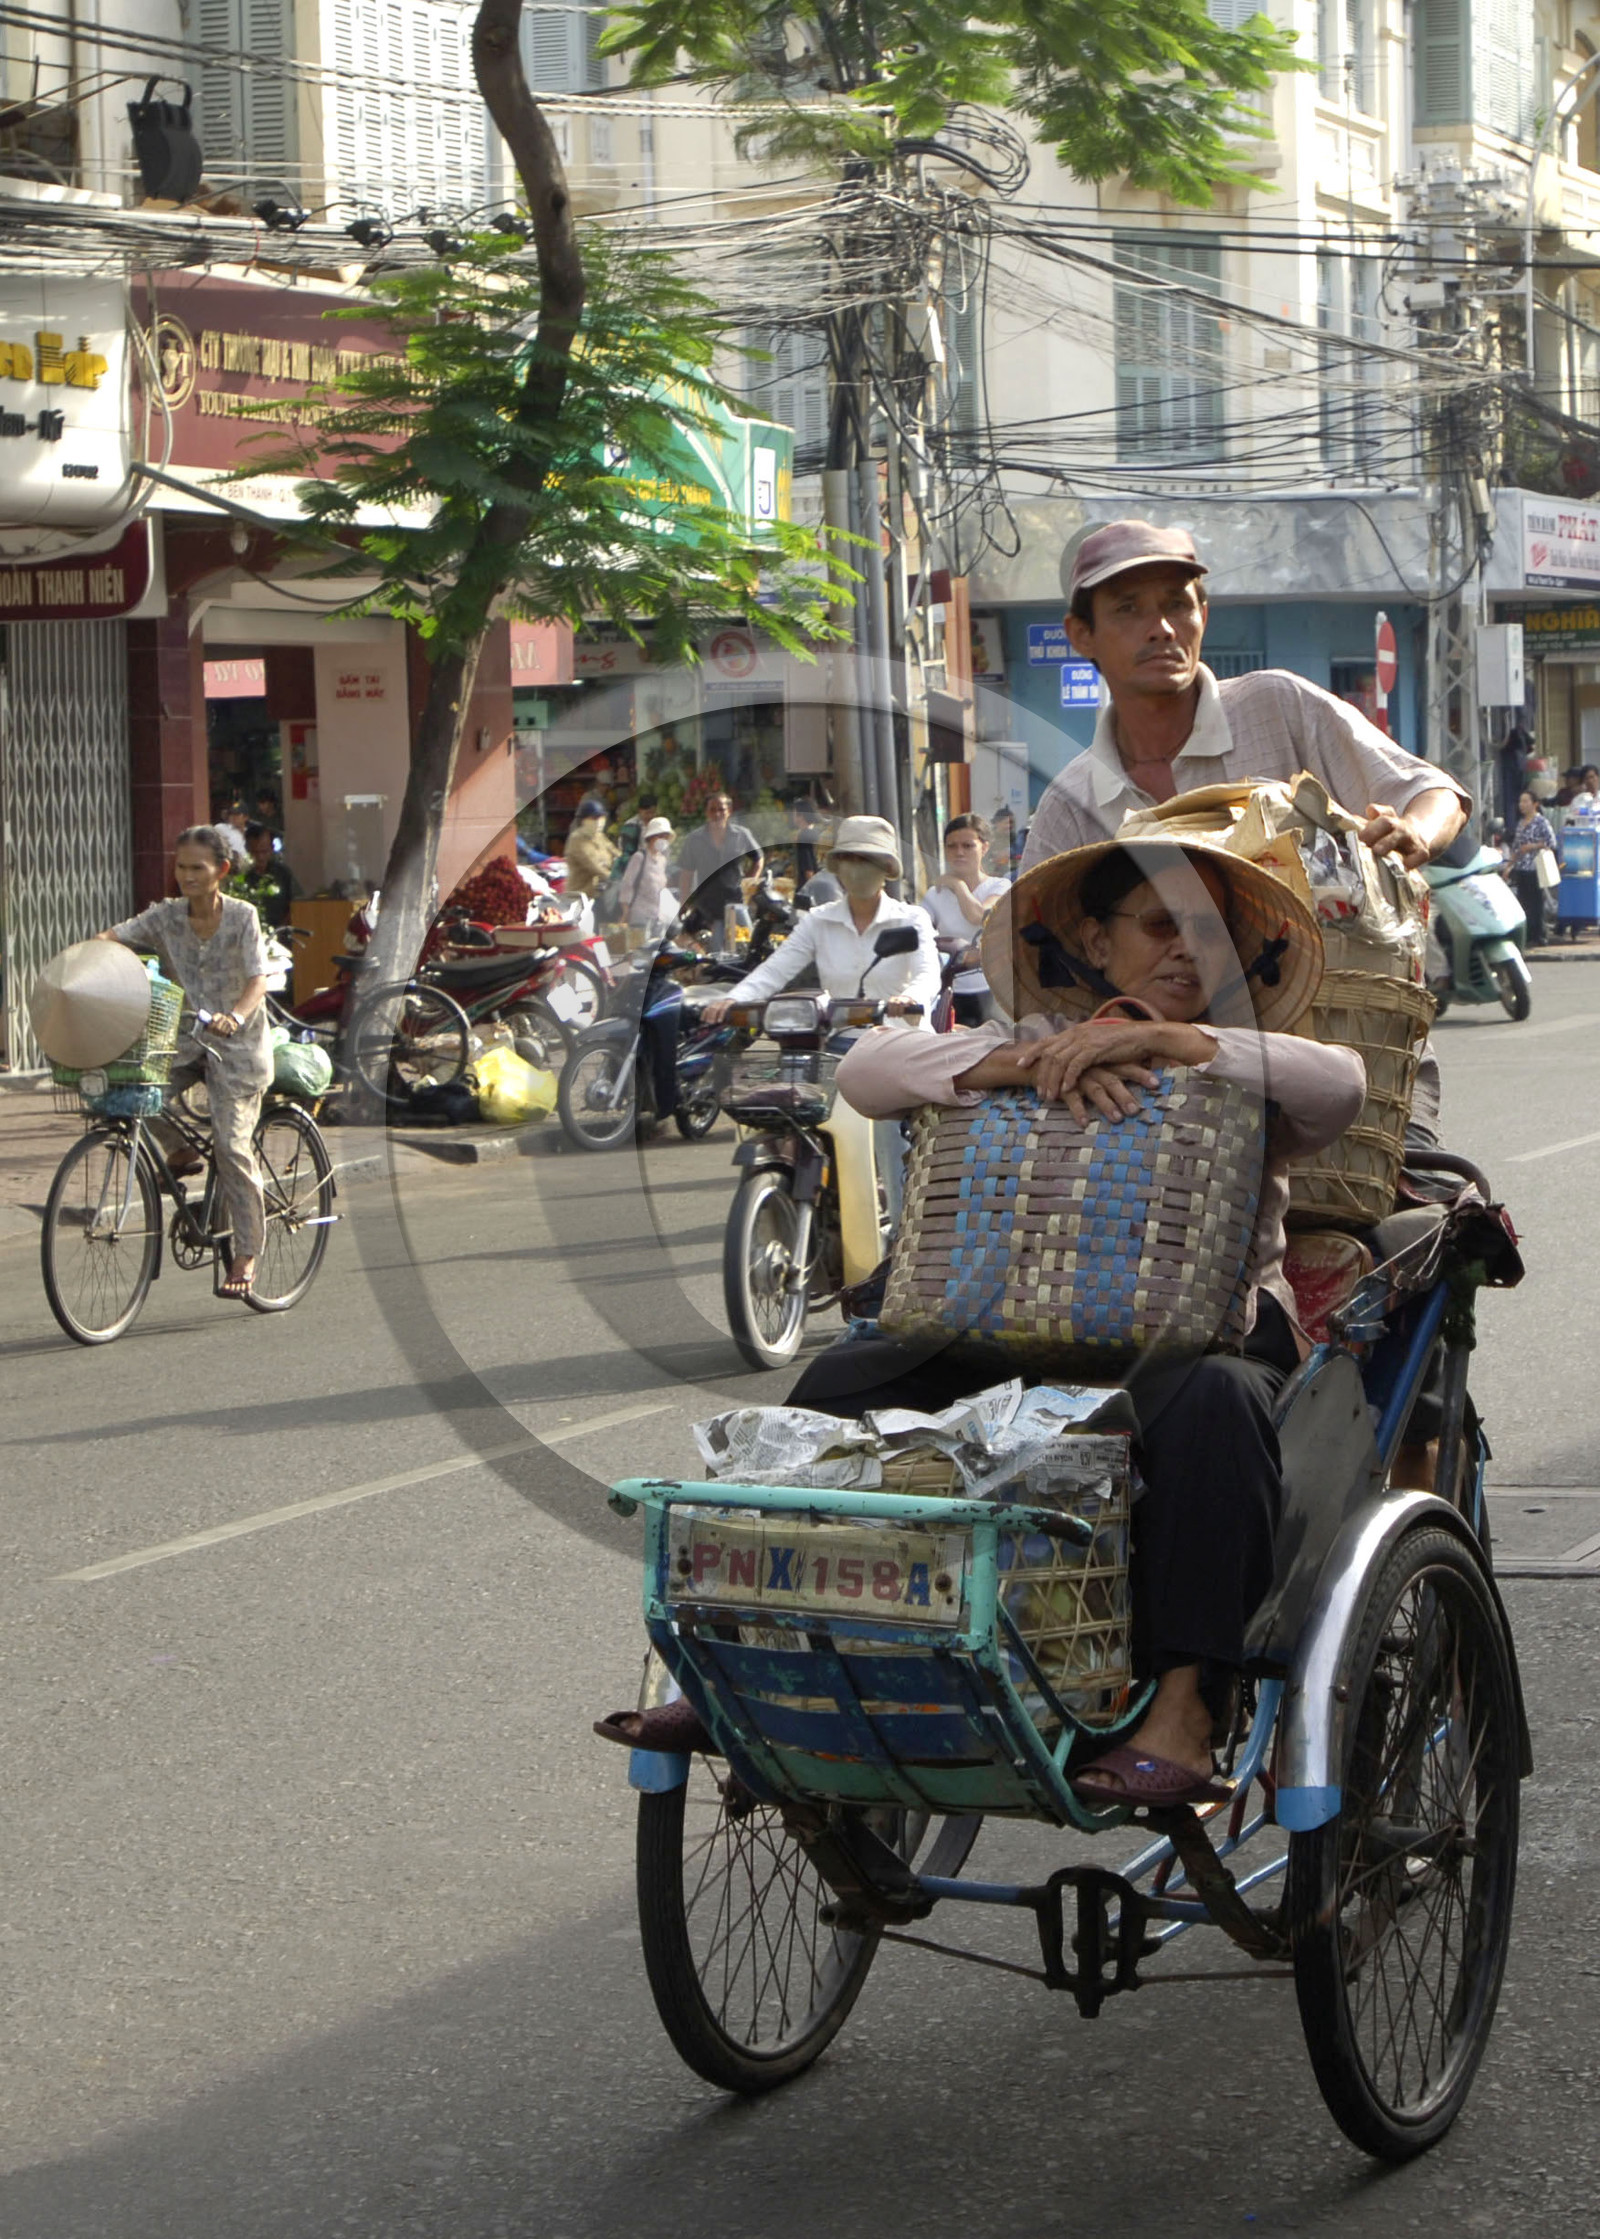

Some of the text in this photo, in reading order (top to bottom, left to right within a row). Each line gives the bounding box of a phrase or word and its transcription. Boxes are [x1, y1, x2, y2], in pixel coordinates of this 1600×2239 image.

[0, 562, 125, 606] OÀN THANH NIÊN
